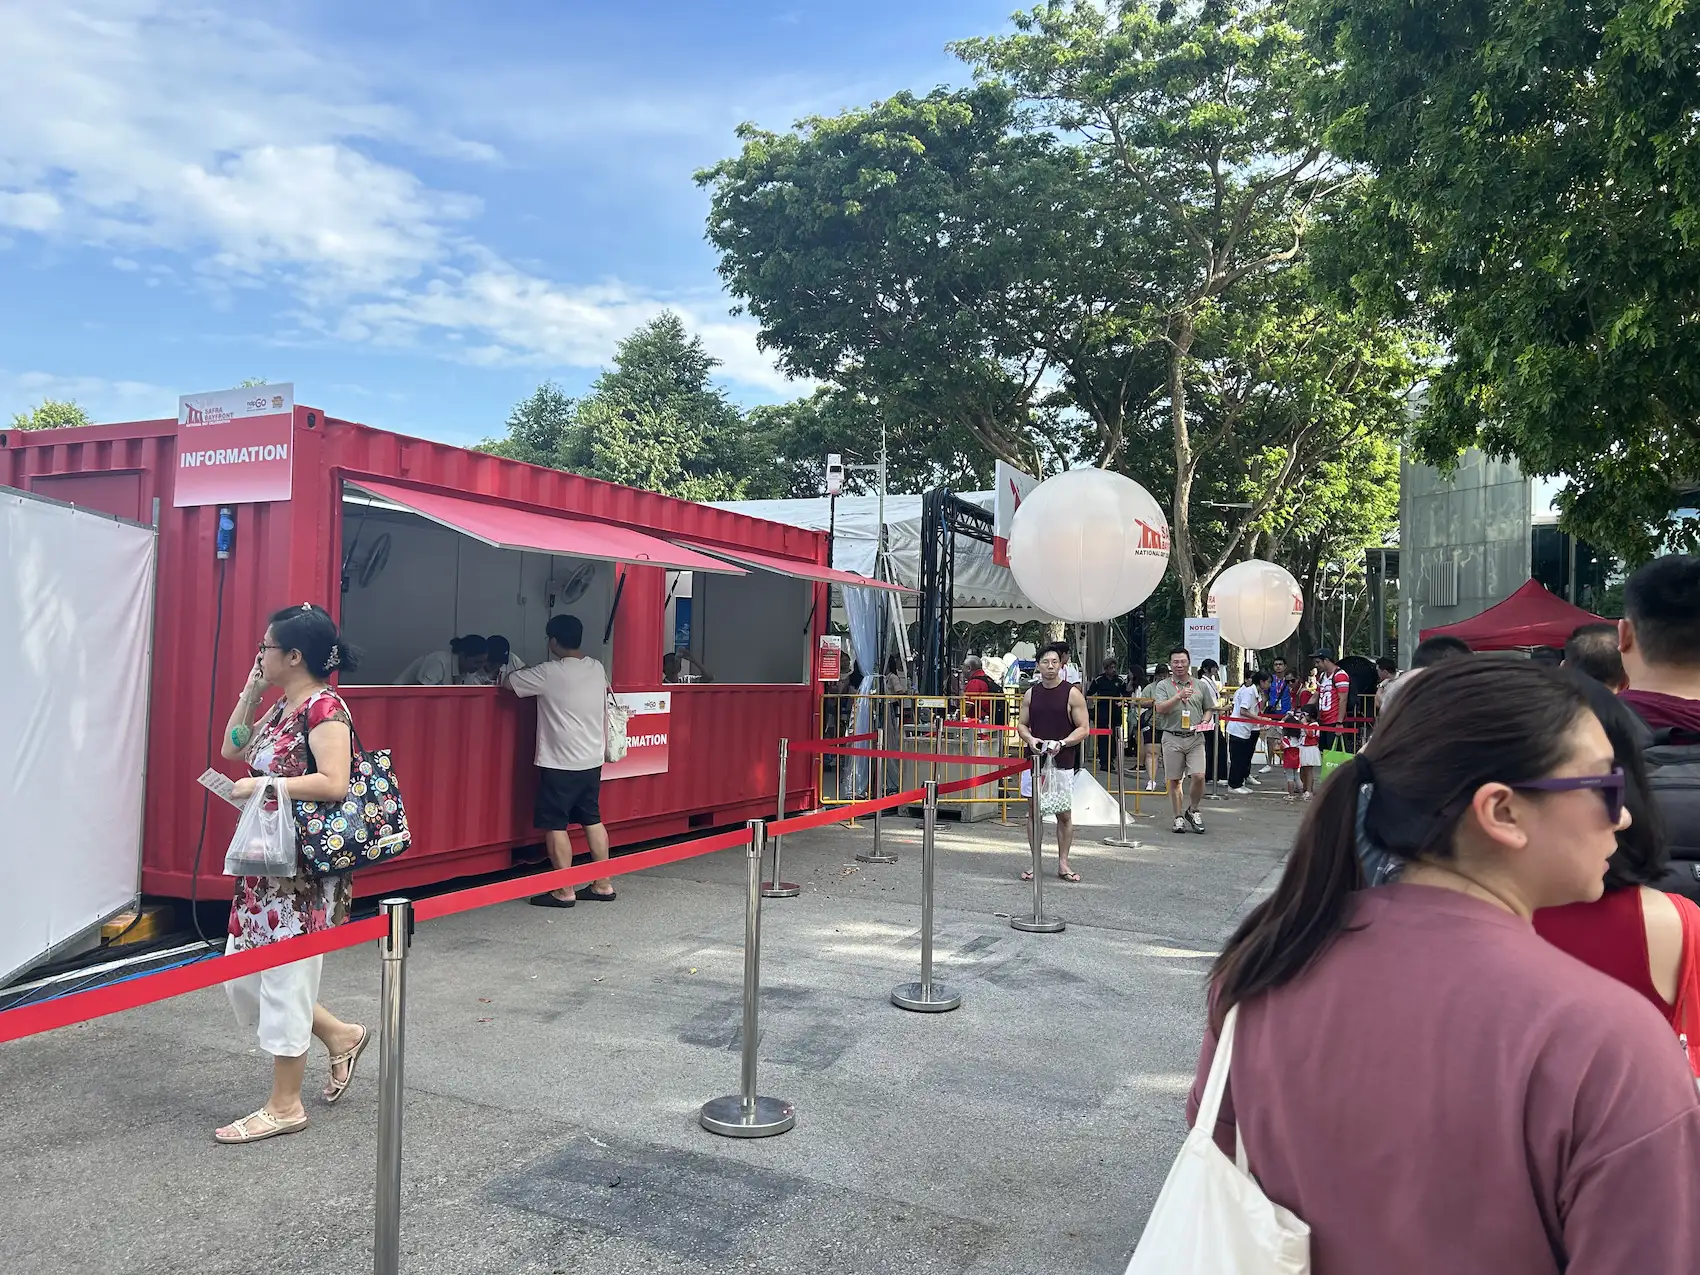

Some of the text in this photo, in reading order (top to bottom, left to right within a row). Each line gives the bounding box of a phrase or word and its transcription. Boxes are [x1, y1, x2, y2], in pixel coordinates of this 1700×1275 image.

[204, 407, 223, 415] SAFRA
[204, 412, 234, 421] BAYFRONT
[180, 444, 288, 468] INFORMATION
[1319, 691, 1332, 712] 0
[626, 734, 667, 747] RMATION
[360, 838, 379, 856] KEVI
